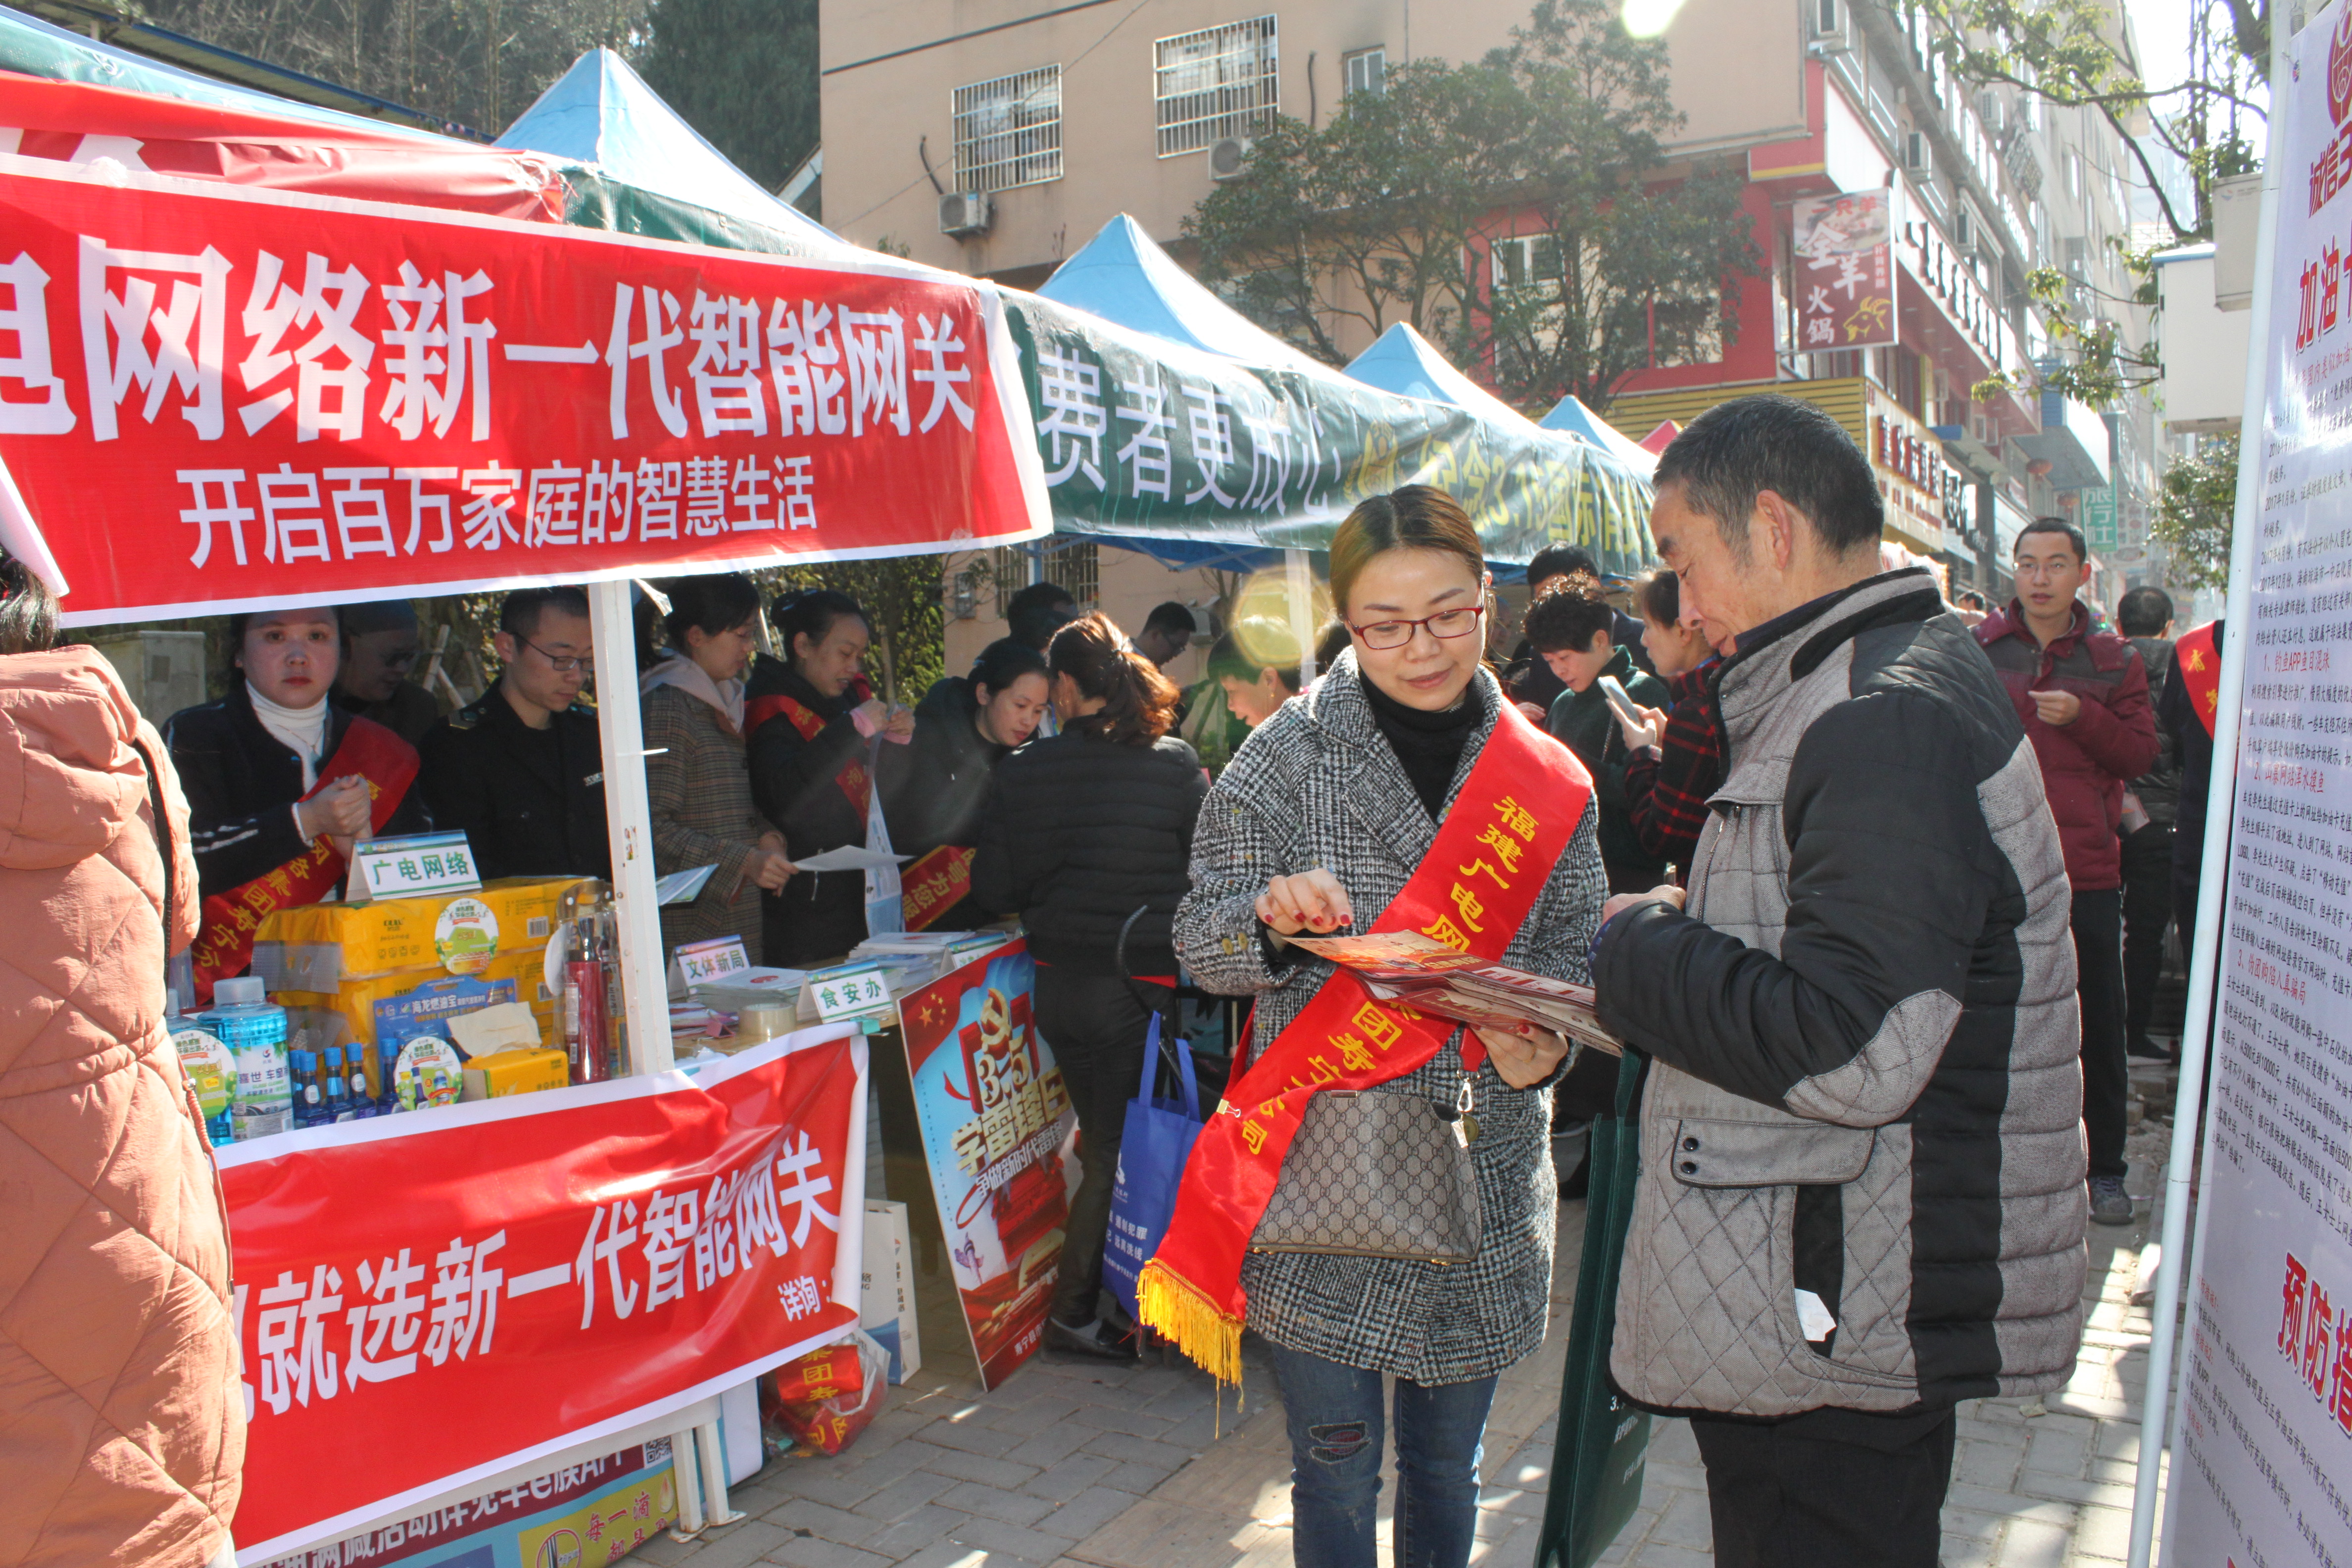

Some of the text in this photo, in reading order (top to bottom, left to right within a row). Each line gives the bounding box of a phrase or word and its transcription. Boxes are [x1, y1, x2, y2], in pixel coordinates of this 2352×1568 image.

[1812, 196, 1877, 216] 一只羊
[176, 454, 818, 569] 开启百万家庭的智慧生活
[2083, 486, 2113, 543] 旅行社
[373, 851, 469, 885] 广电网络
[686, 949, 745, 979] 文体新局
[821, 977, 882, 1009] 食安办
[977, 1034, 1029, 1107] 3.5
[233, 1129, 840, 1422] 就选新一代智能网关
[585, 1491, 650, 1543] 每一滴
